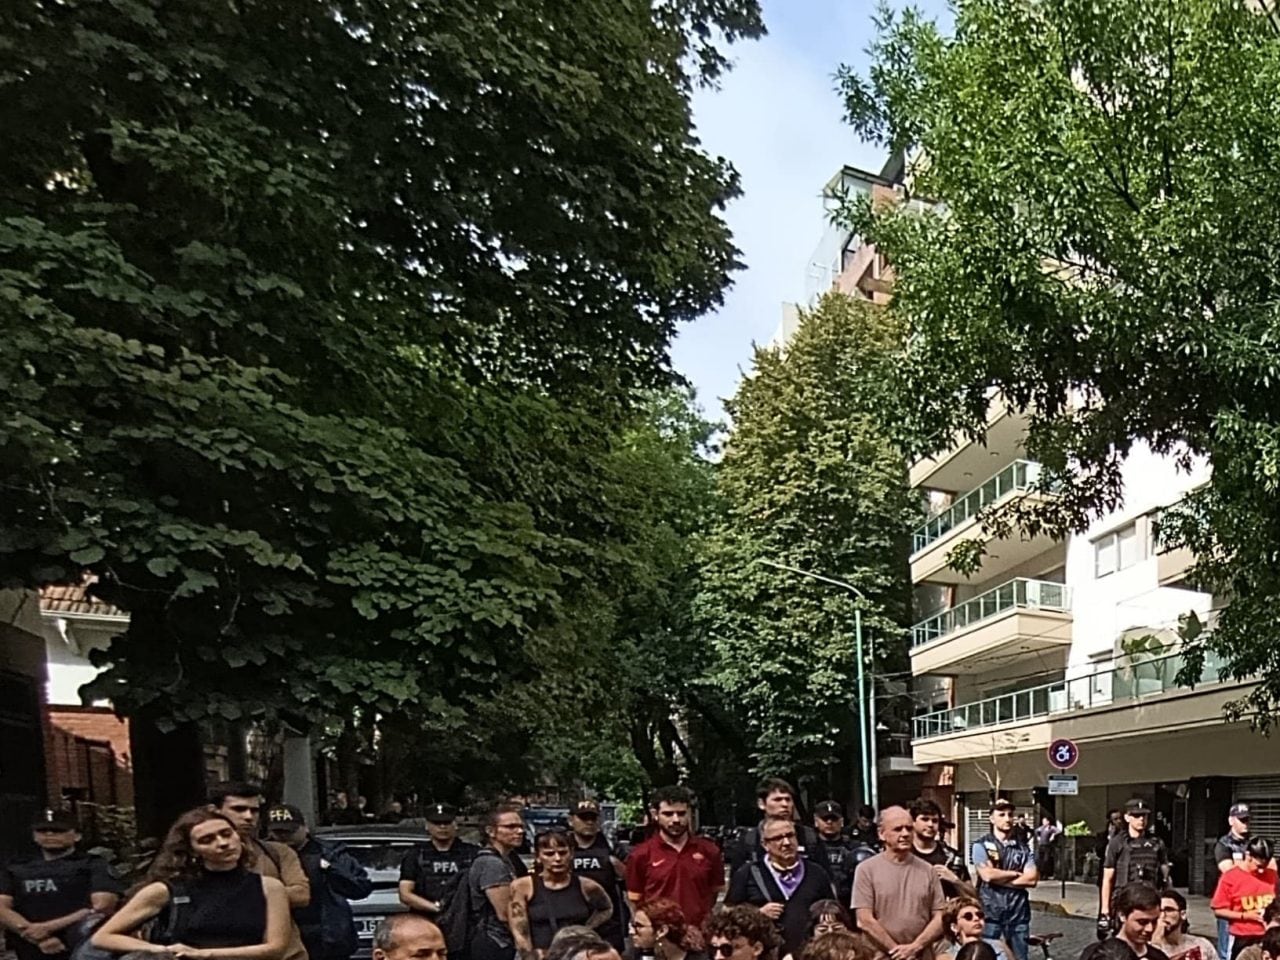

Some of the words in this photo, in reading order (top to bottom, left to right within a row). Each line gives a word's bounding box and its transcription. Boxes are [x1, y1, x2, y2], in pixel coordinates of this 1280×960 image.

[433, 862, 459, 872] PFA
[572, 858, 601, 869] PFA
[24, 879, 57, 892] PFA
